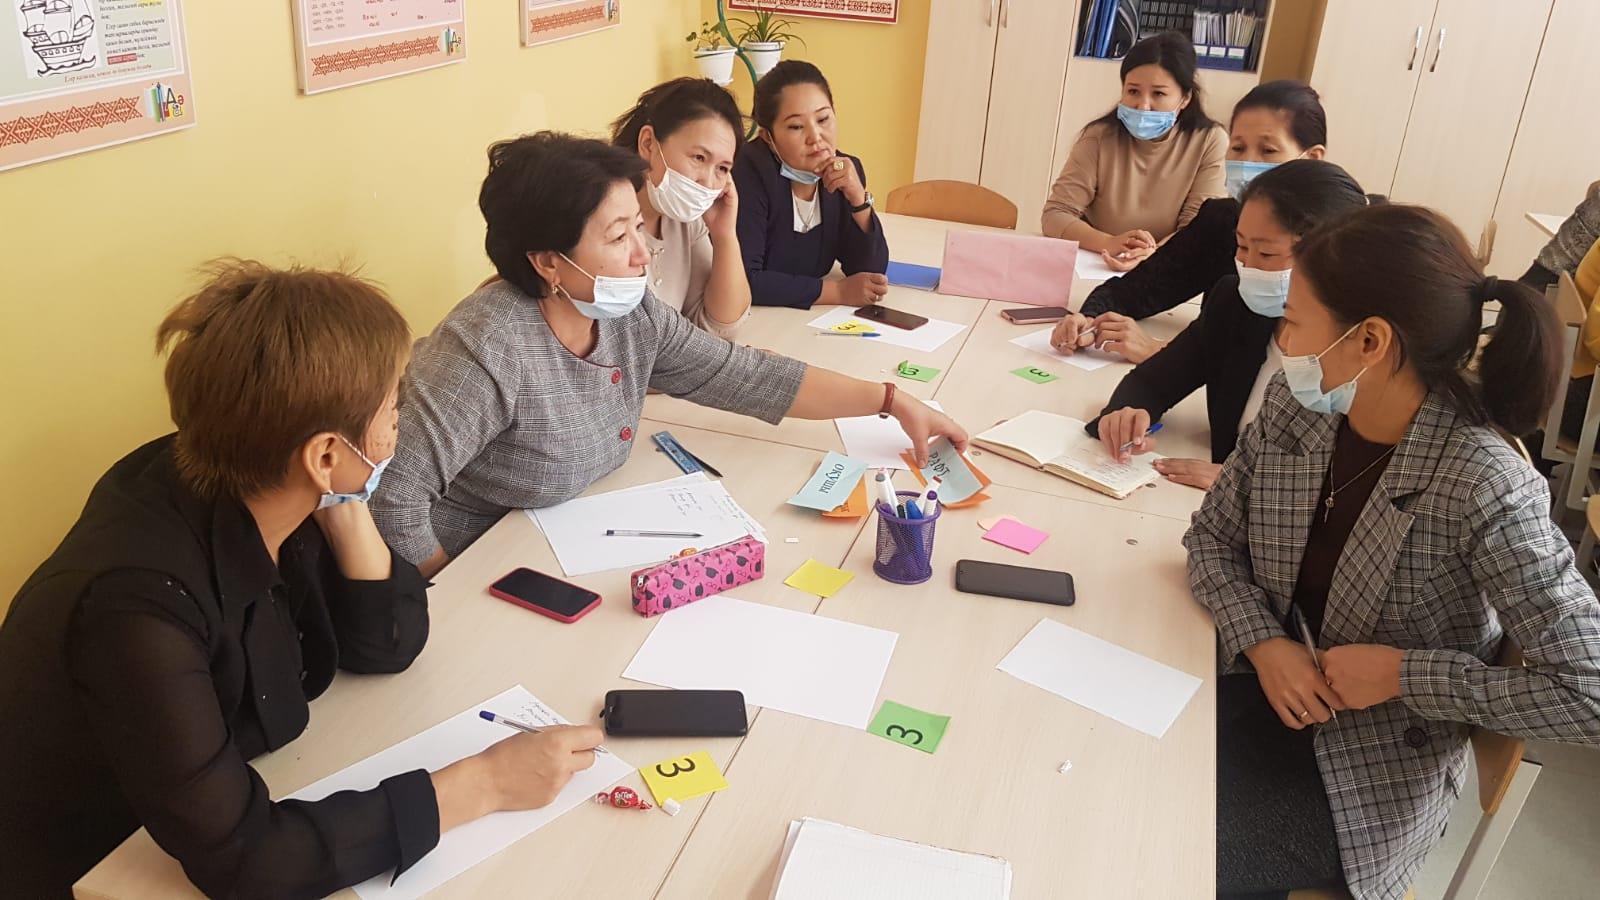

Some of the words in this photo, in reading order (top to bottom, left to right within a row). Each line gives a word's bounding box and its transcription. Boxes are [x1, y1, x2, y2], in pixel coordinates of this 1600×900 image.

[837, 323, 857, 331] 3
[1029, 368, 1050, 378] 3
[886, 724, 924, 745] 3
[655, 757, 696, 778] 3
